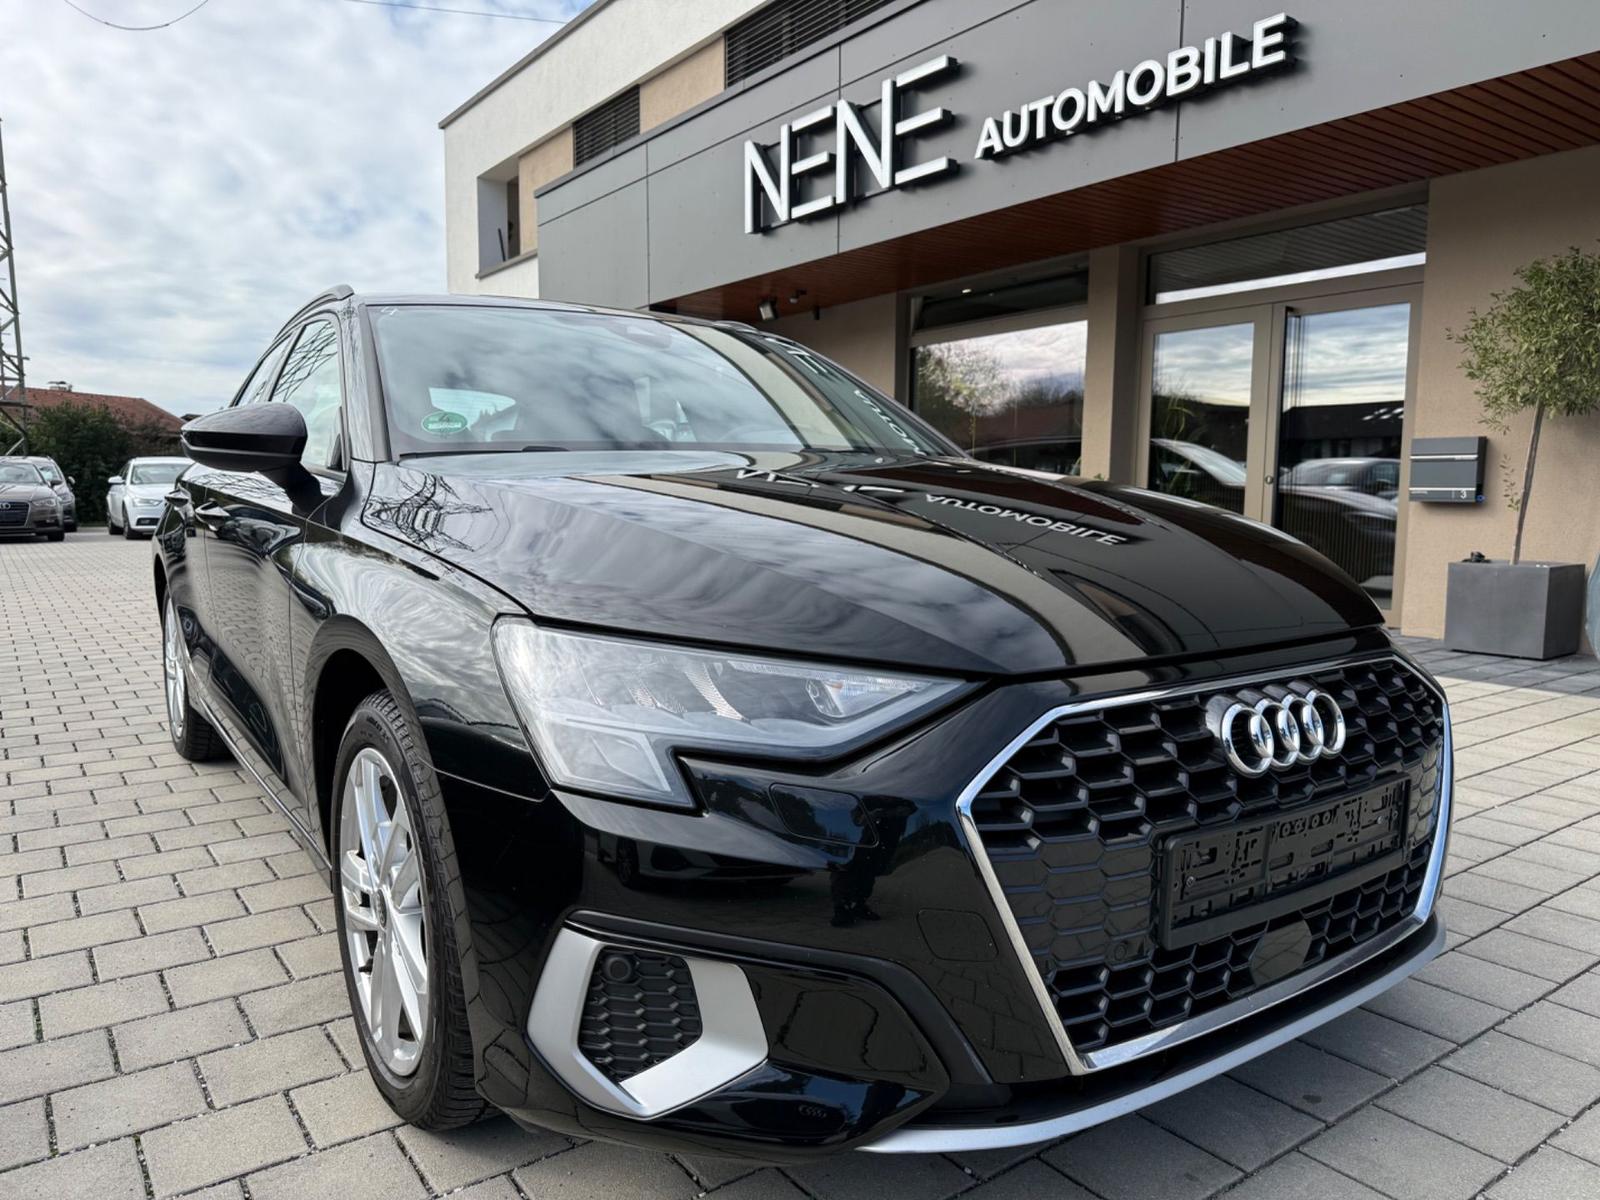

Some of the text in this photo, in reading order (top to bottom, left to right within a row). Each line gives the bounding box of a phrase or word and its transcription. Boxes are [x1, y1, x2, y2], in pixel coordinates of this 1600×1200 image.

[744, 13, 1288, 234] NENE AUTOMOBILE
[1460, 490, 1467, 499] 3
